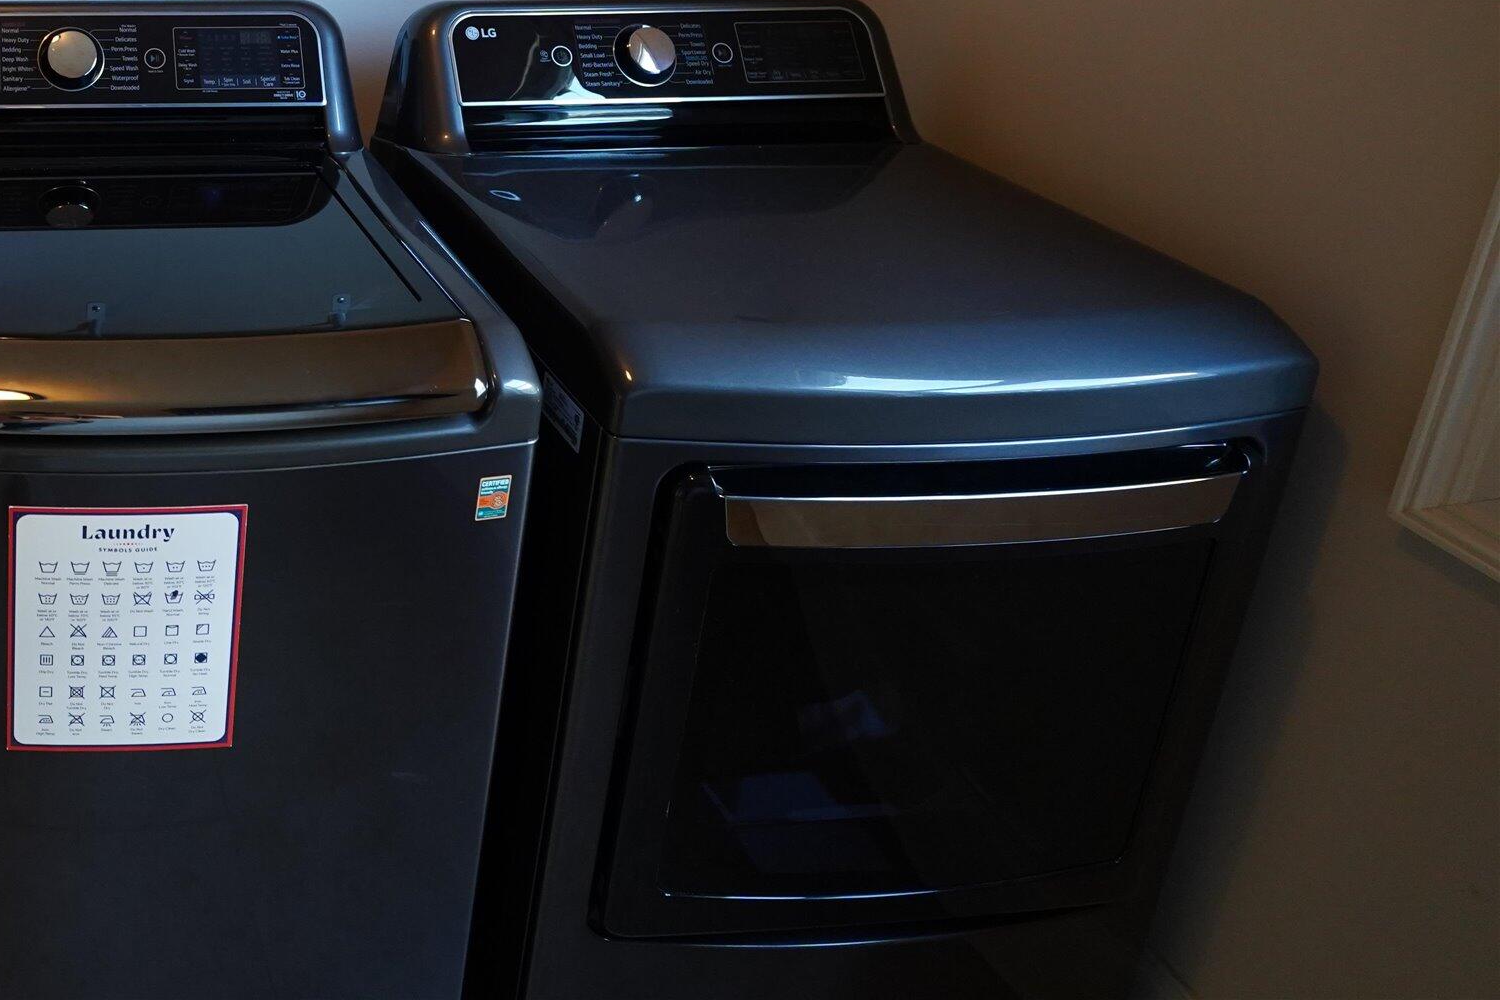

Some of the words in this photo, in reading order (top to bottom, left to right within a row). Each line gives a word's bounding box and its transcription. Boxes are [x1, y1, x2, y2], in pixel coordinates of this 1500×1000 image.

[481, 28, 497, 38] LG
[482, 479, 509, 487] CERTIFIED
[82, 524, 175, 542] Laundry
